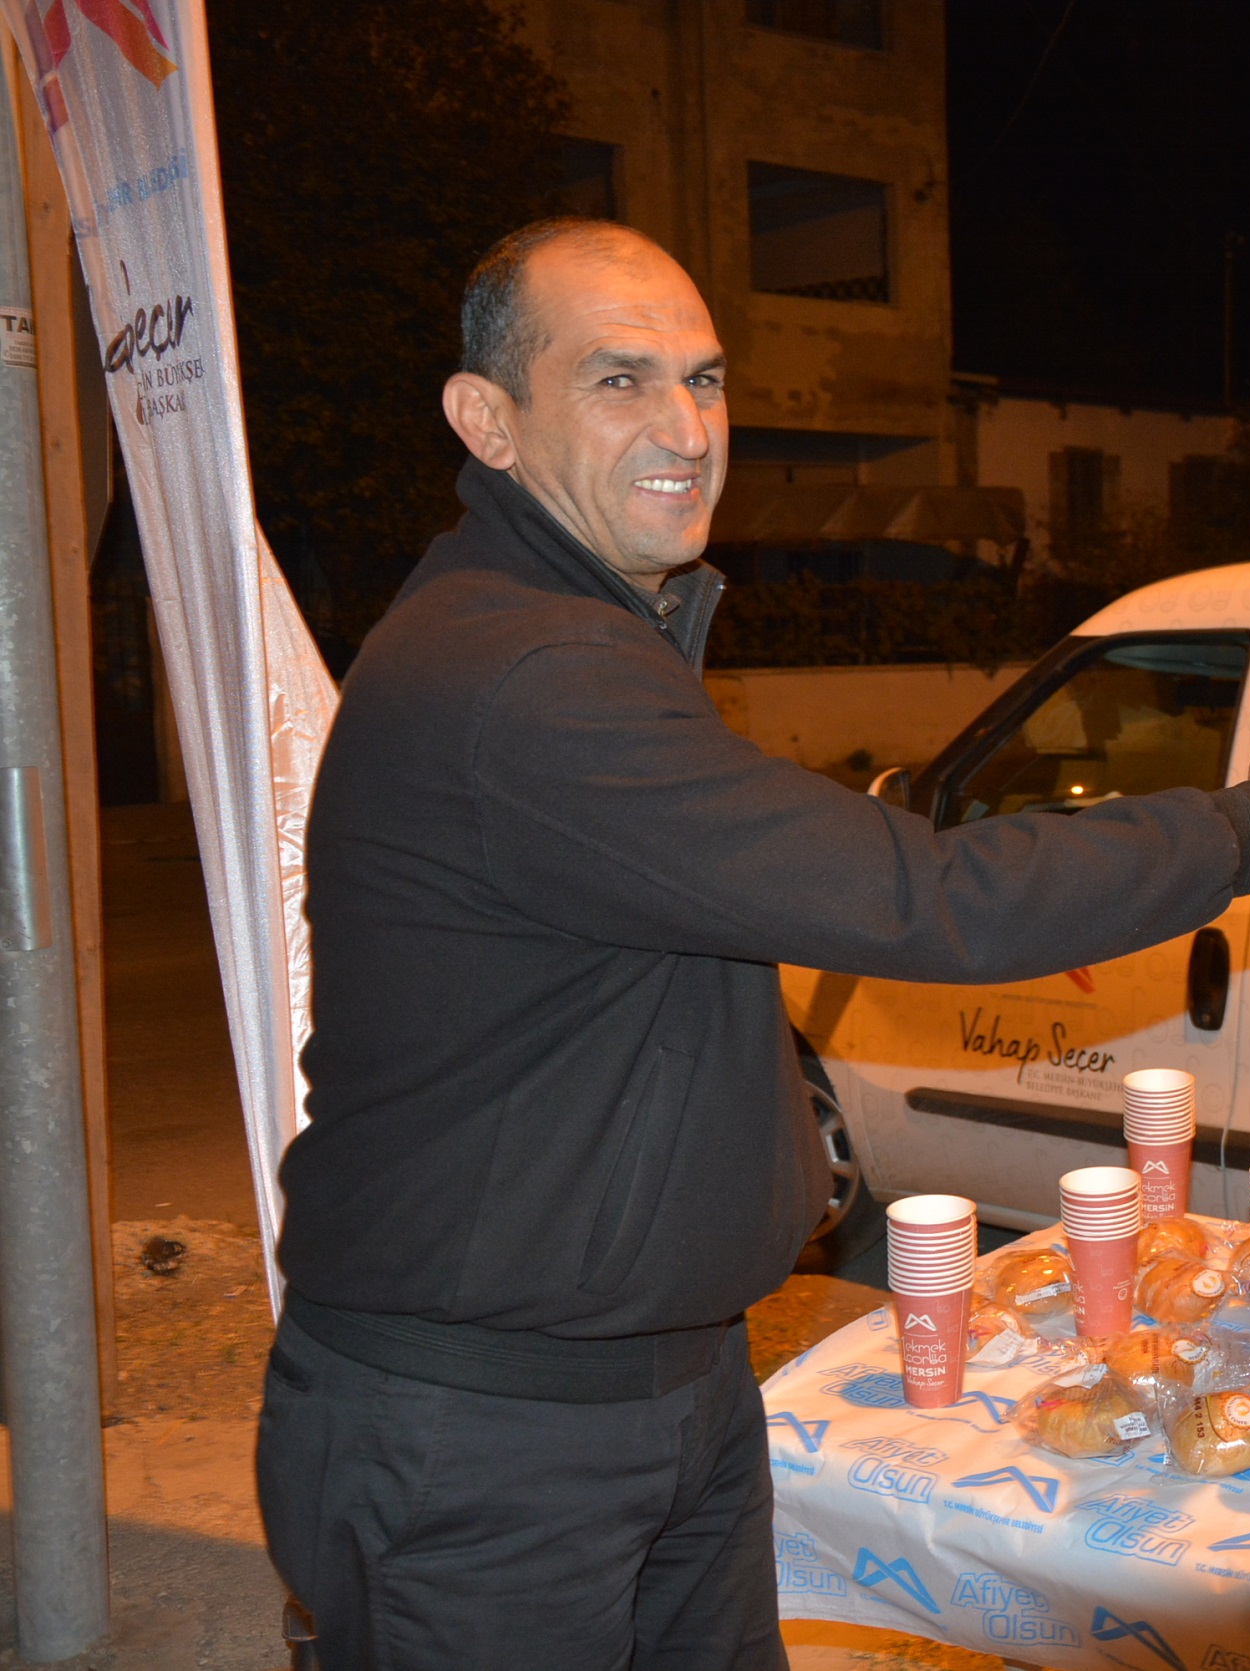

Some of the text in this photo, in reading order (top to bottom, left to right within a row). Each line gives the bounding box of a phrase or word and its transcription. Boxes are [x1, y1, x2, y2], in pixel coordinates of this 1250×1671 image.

[0, 314, 33, 335] TA
[960, 1007, 1115, 1085] Vahap Seçer
[1142, 1180, 1176, 1193] ekmek
[905, 1339, 946, 1353] ekmek
[1196, 1422, 1205, 1439] 153
[855, 1438, 934, 1466] Afiyet
[854, 1456, 933, 1499] Olsun
[1095, 1495, 1186, 1528] Afiyet
[1090, 1519, 1180, 1560] Olsun
[956, 1578, 1048, 1612] Afiyet
[989, 1613, 1079, 1642] Olsun
